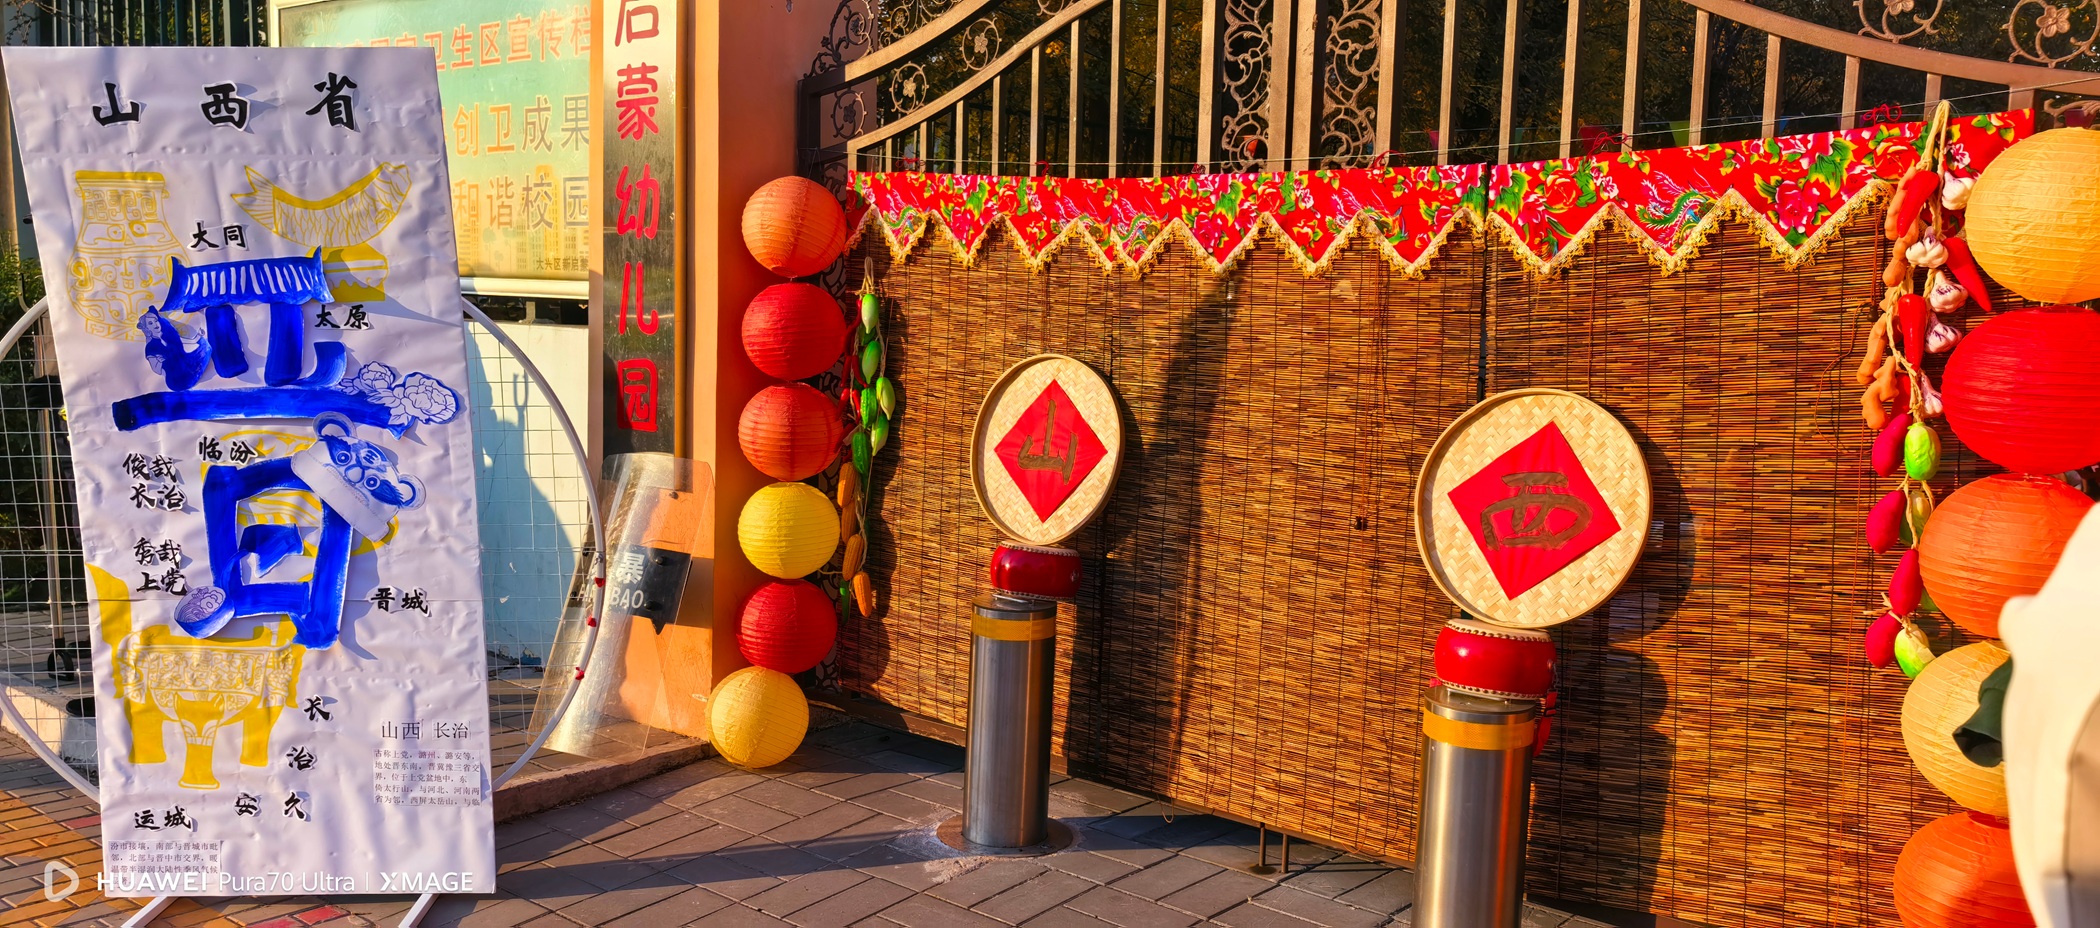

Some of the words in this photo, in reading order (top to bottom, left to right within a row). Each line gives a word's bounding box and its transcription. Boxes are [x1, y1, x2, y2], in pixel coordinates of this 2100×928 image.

[92, 72, 359, 131] 山西省
[442, 94, 590, 157] 创卫成果
[452, 174, 590, 230] 和谐校园
[189, 221, 247, 249] 大同
[314, 304, 370, 330] 太原
[198, 436, 257, 464] 临汾
[1018, 399, 1079, 486] 山
[122, 453, 177, 483] 俊哉
[129, 484, 185, 509] 长治
[1480, 471, 1594, 551] 西
[133, 537, 180, 568] 秀哉
[135, 567, 188, 596] 上党
[370, 587, 430, 614] 晋城
[610, 586, 645, 609] BAO
[381, 720, 421, 741] 山西
[433, 721, 469, 740] 长治
[134, 805, 193, 830] 运城
